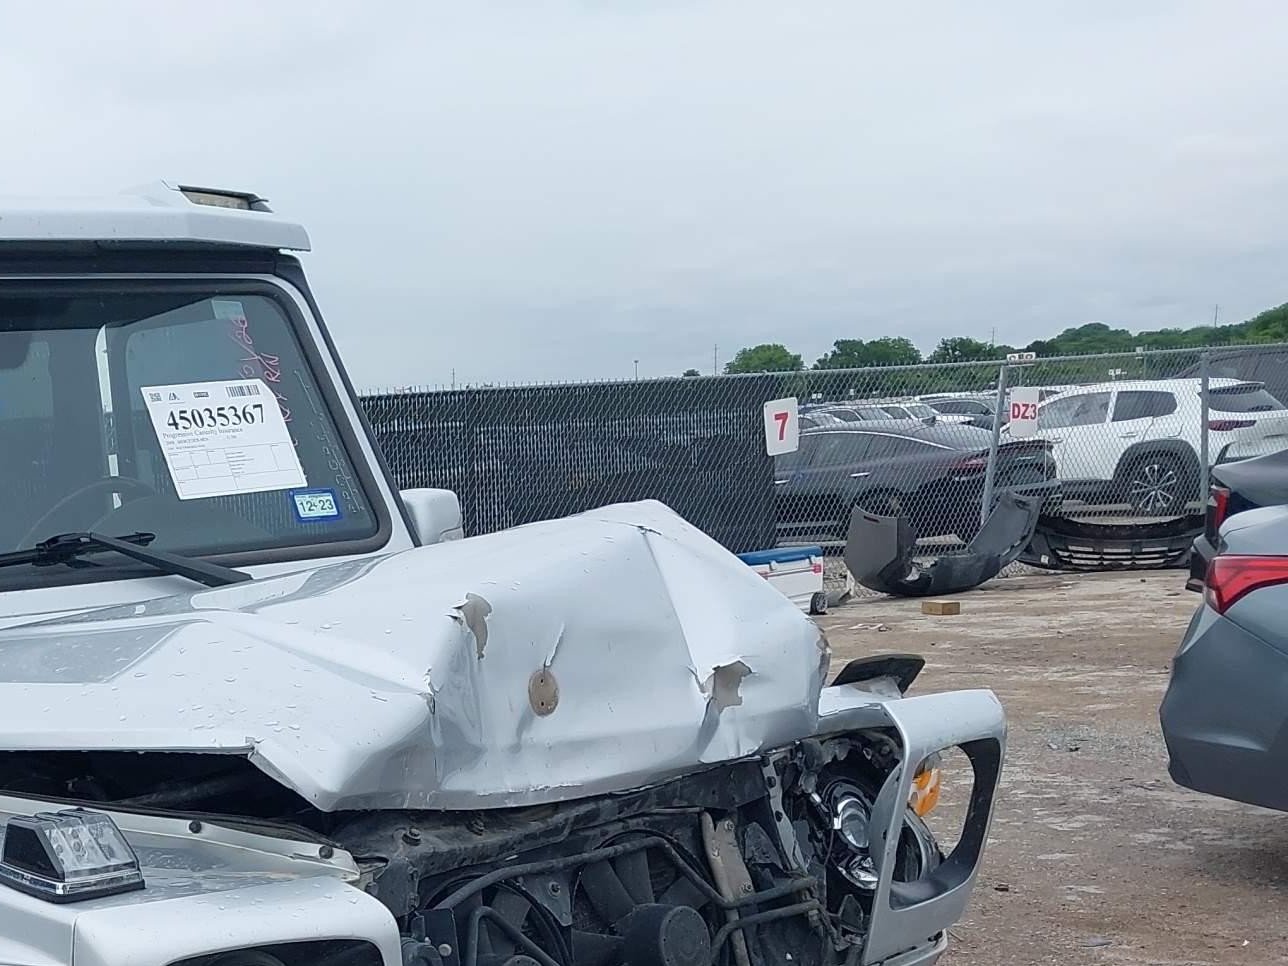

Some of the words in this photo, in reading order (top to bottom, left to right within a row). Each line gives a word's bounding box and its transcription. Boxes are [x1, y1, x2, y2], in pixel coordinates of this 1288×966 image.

[167, 404, 264, 430] 45035367
[1012, 403, 1037, 420] DZ3
[774, 412, 789, 441] 7
